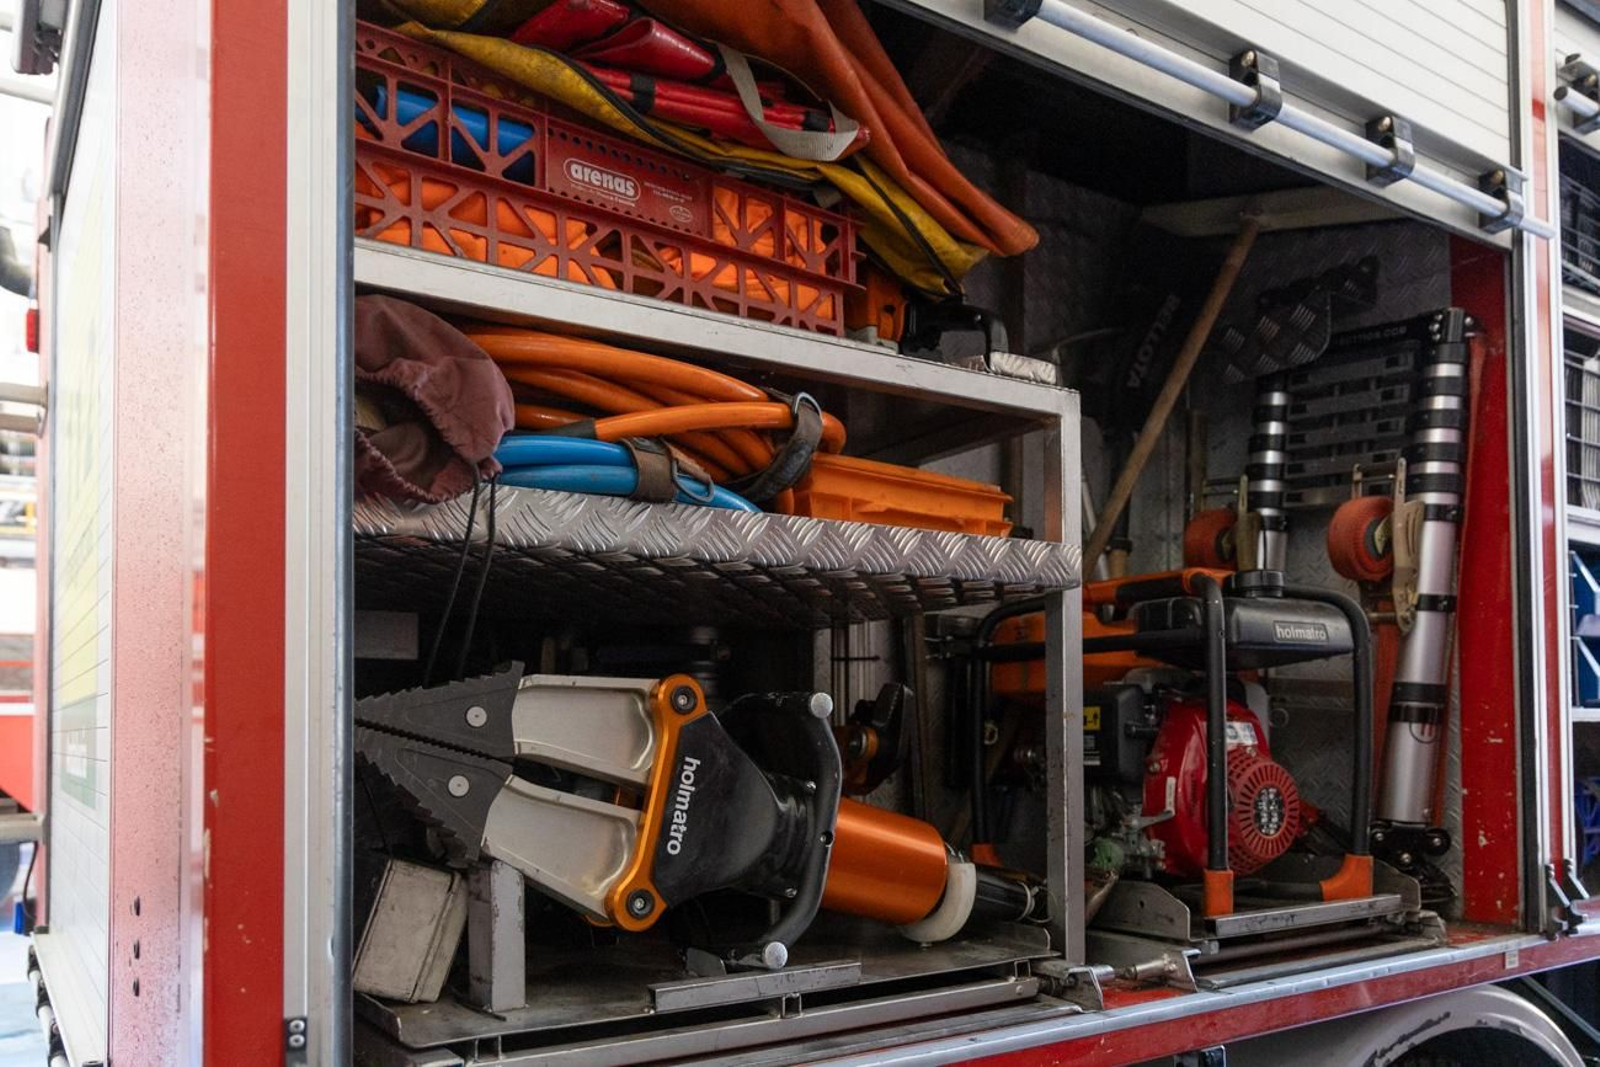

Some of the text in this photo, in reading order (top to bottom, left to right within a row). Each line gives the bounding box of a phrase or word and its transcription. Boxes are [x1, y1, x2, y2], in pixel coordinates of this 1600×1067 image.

[570, 163, 635, 197] arenas
[1276, 625, 1326, 640] holmatro
[666, 756, 701, 855] holmatro
